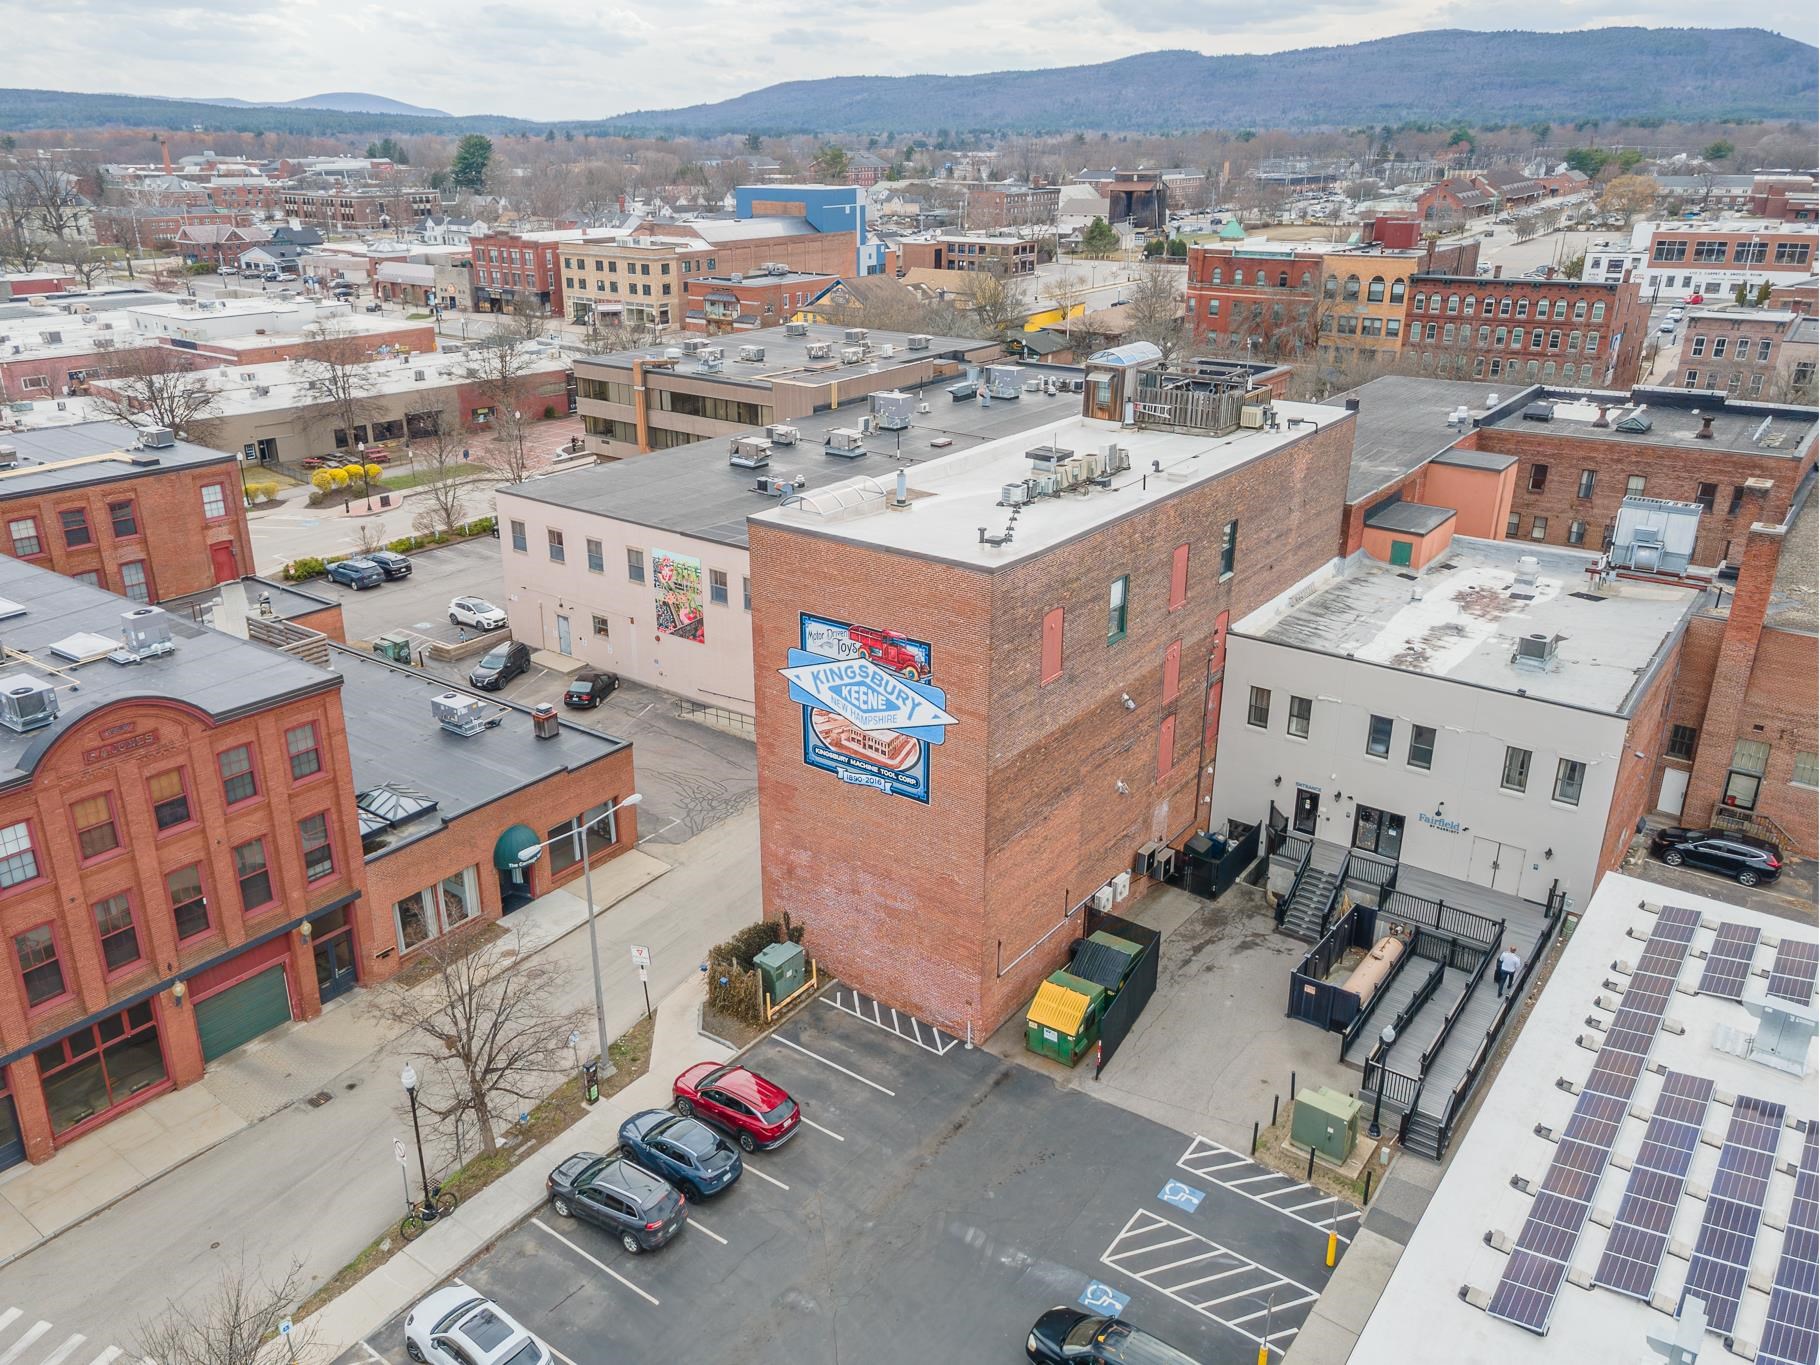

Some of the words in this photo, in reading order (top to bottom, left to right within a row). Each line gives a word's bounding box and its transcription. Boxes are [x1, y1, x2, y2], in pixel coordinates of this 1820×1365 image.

[808, 630, 825, 641] Motor
[827, 628, 848, 640] Driven
[833, 638, 858, 656] Toys
[811, 664, 923, 721] KINGSBURY
[841, 685, 887, 710] KEENE
[830, 695, 848, 713] NEW
[850, 708, 898, 726] HAMPSHIRE
[815, 747, 848, 763] KINGSBURY
[850, 758, 879, 772] MACHINE
[880, 768, 897, 779] TOOL
[898, 774, 917, 786] CORP.
[1418, 812, 1460, 831] Fairfield
